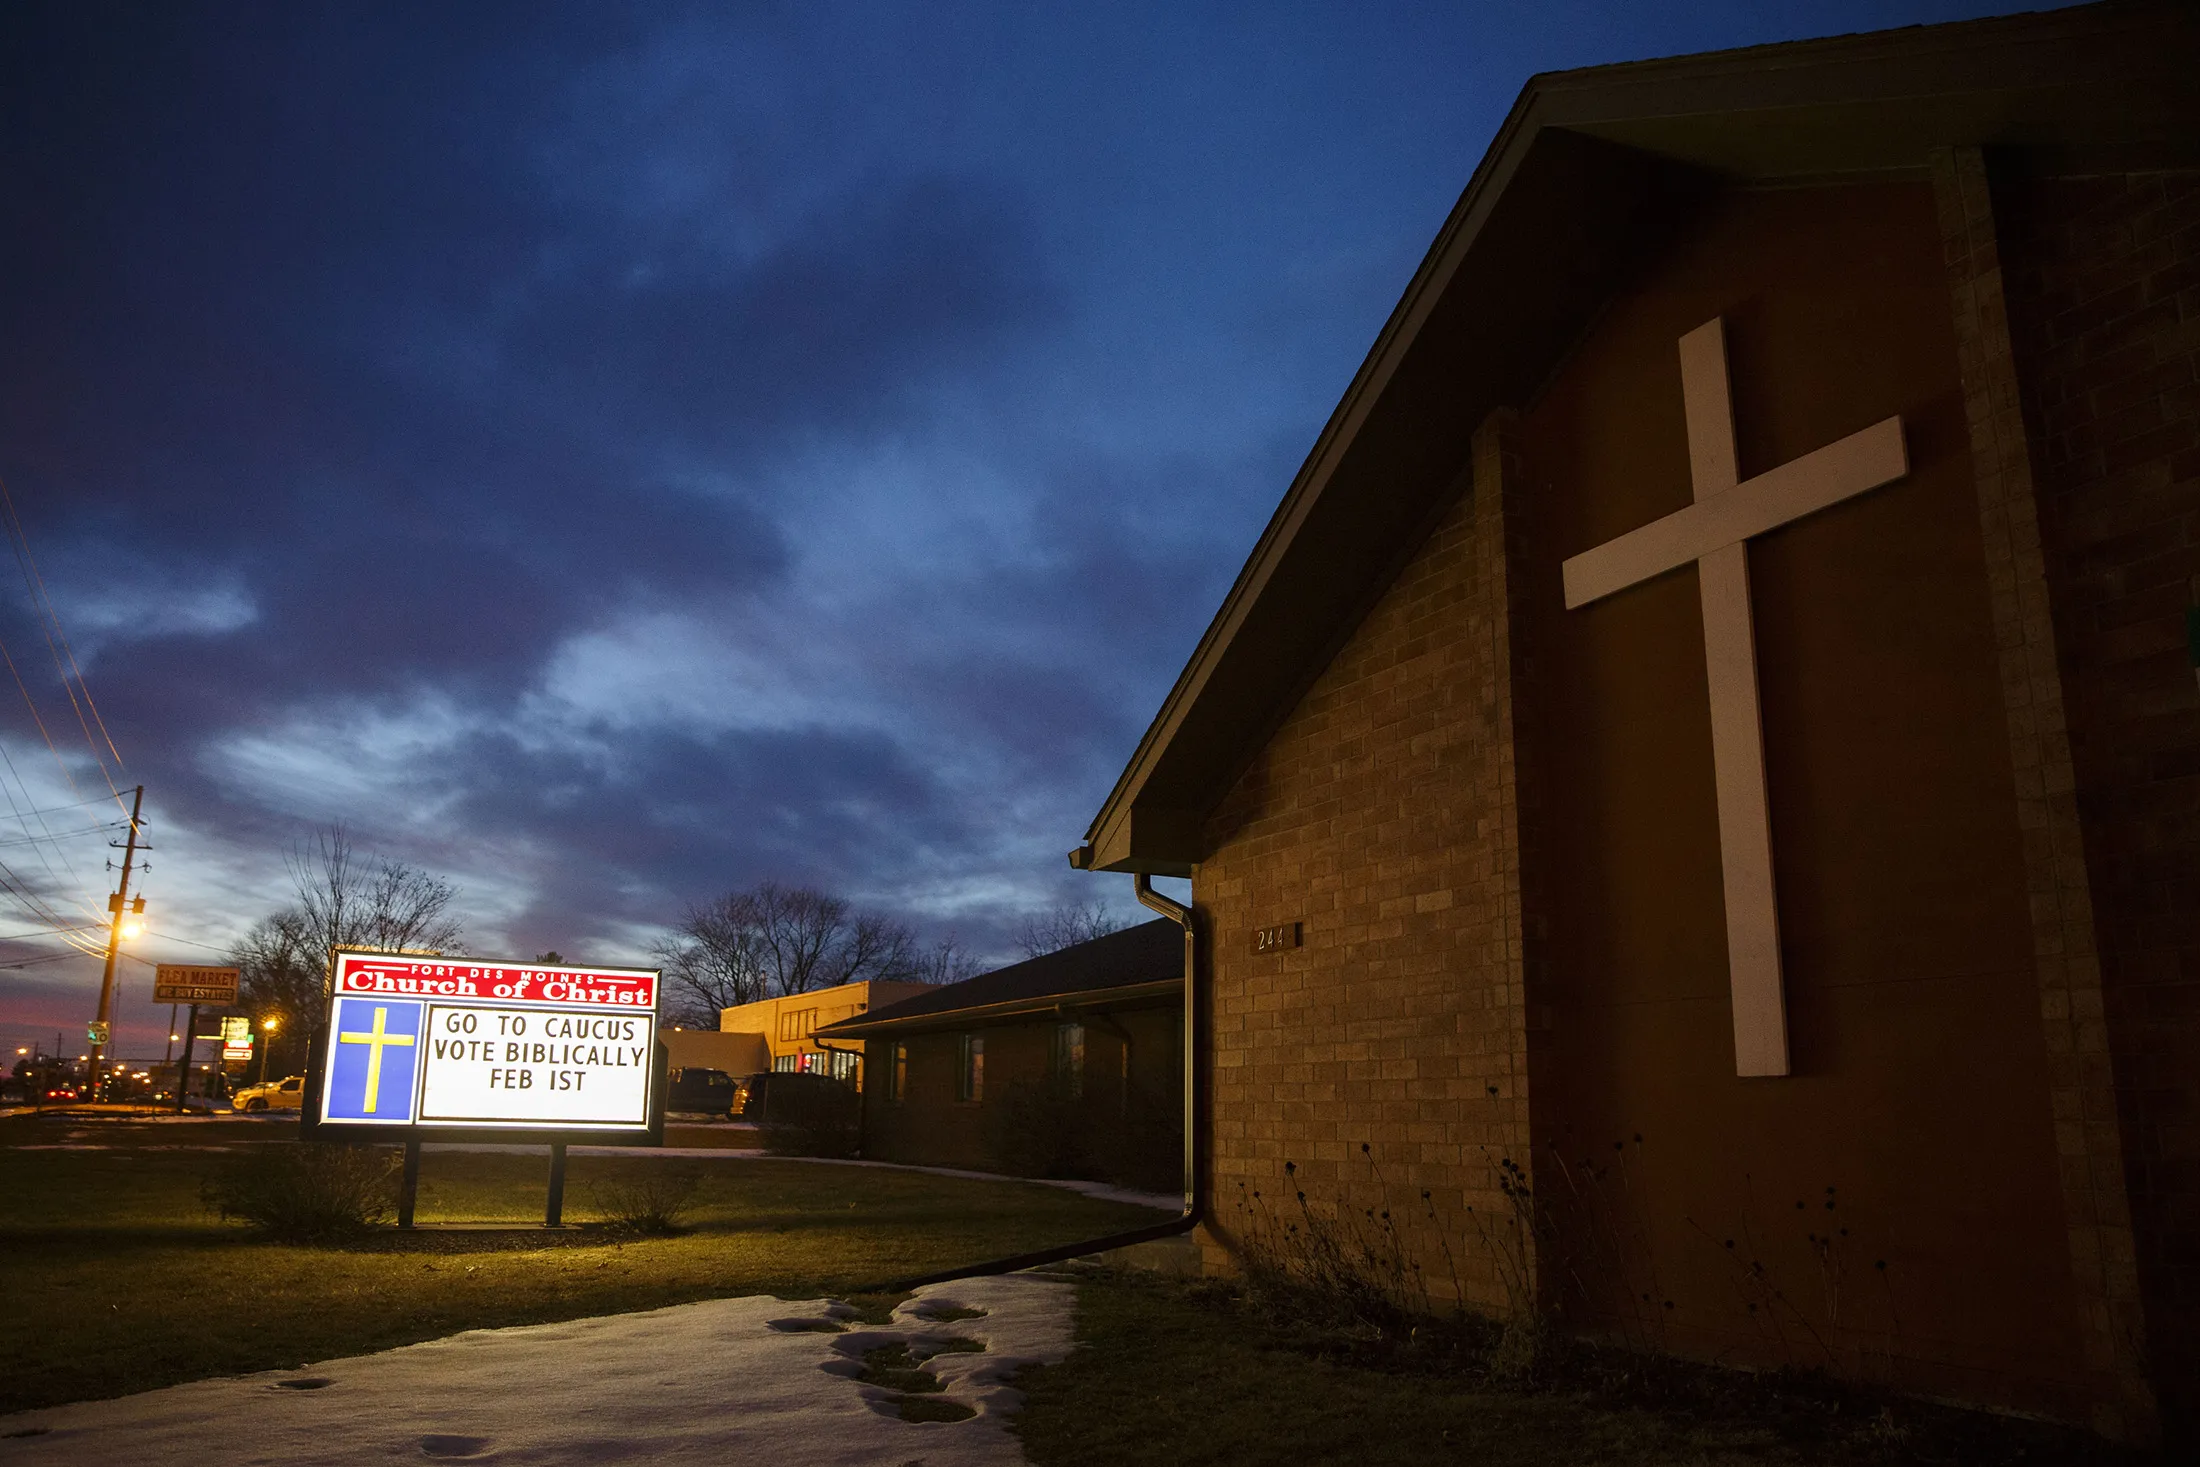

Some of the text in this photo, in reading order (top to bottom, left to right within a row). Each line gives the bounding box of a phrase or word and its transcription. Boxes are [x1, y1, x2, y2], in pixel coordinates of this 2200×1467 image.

[1258, 927, 1284, 950] 244
[158, 969, 237, 985] FLEA MARKET
[411, 964, 595, 985] FORT DES MOINES
[347, 970, 648, 1005] Church of Christ
[446, 1013, 635, 1041] GO TO CAUCUS
[434, 1039, 644, 1067] VOTE BIBLICALLY
[490, 1068, 533, 1089] FEB
